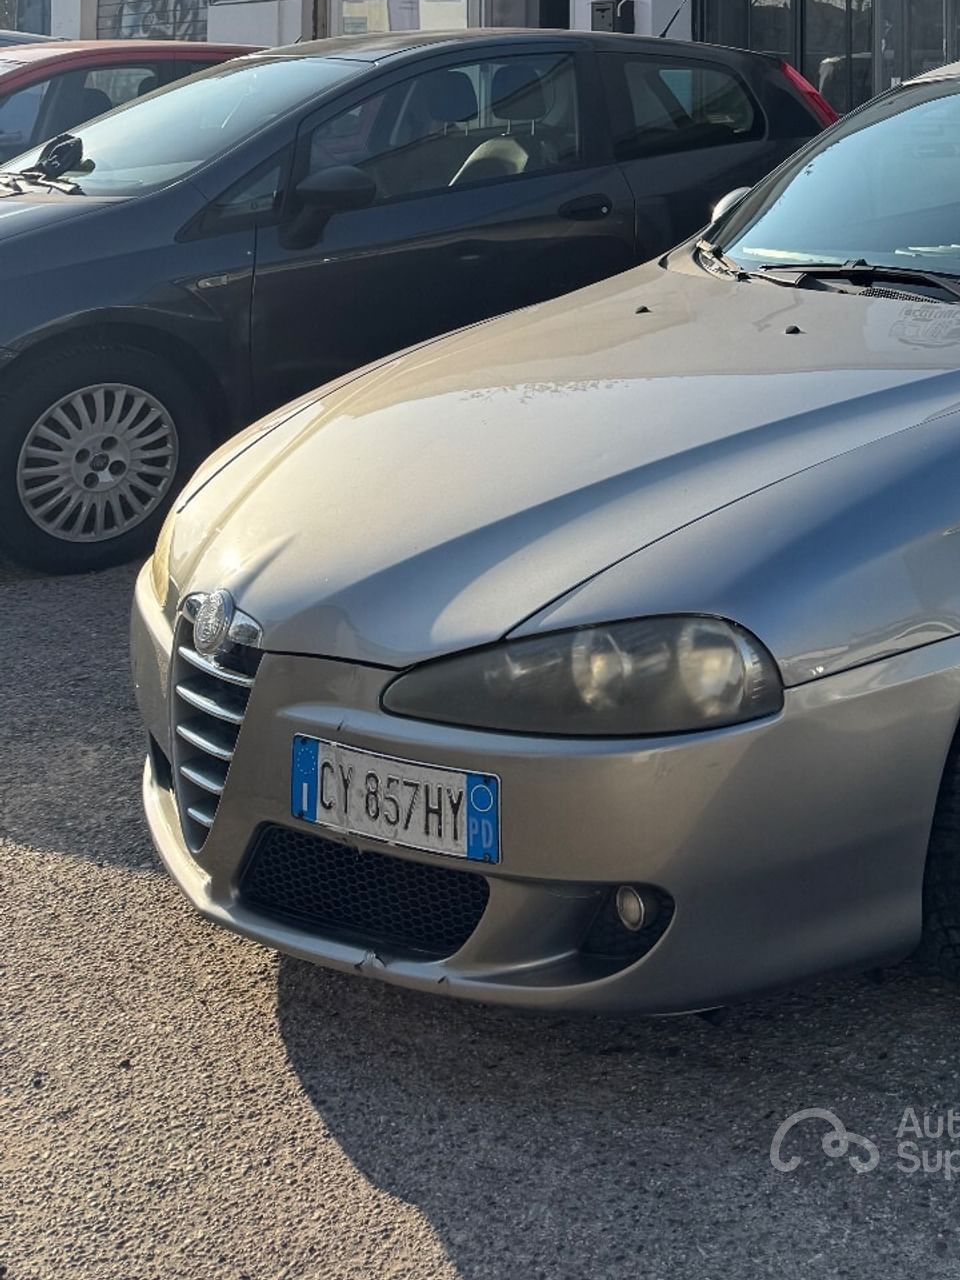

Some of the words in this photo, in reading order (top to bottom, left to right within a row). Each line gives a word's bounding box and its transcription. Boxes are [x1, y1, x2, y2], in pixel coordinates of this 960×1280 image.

[320, 761, 352, 814] CY
[365, 770, 463, 841] 857HY
[469, 817, 494, 849] PD
